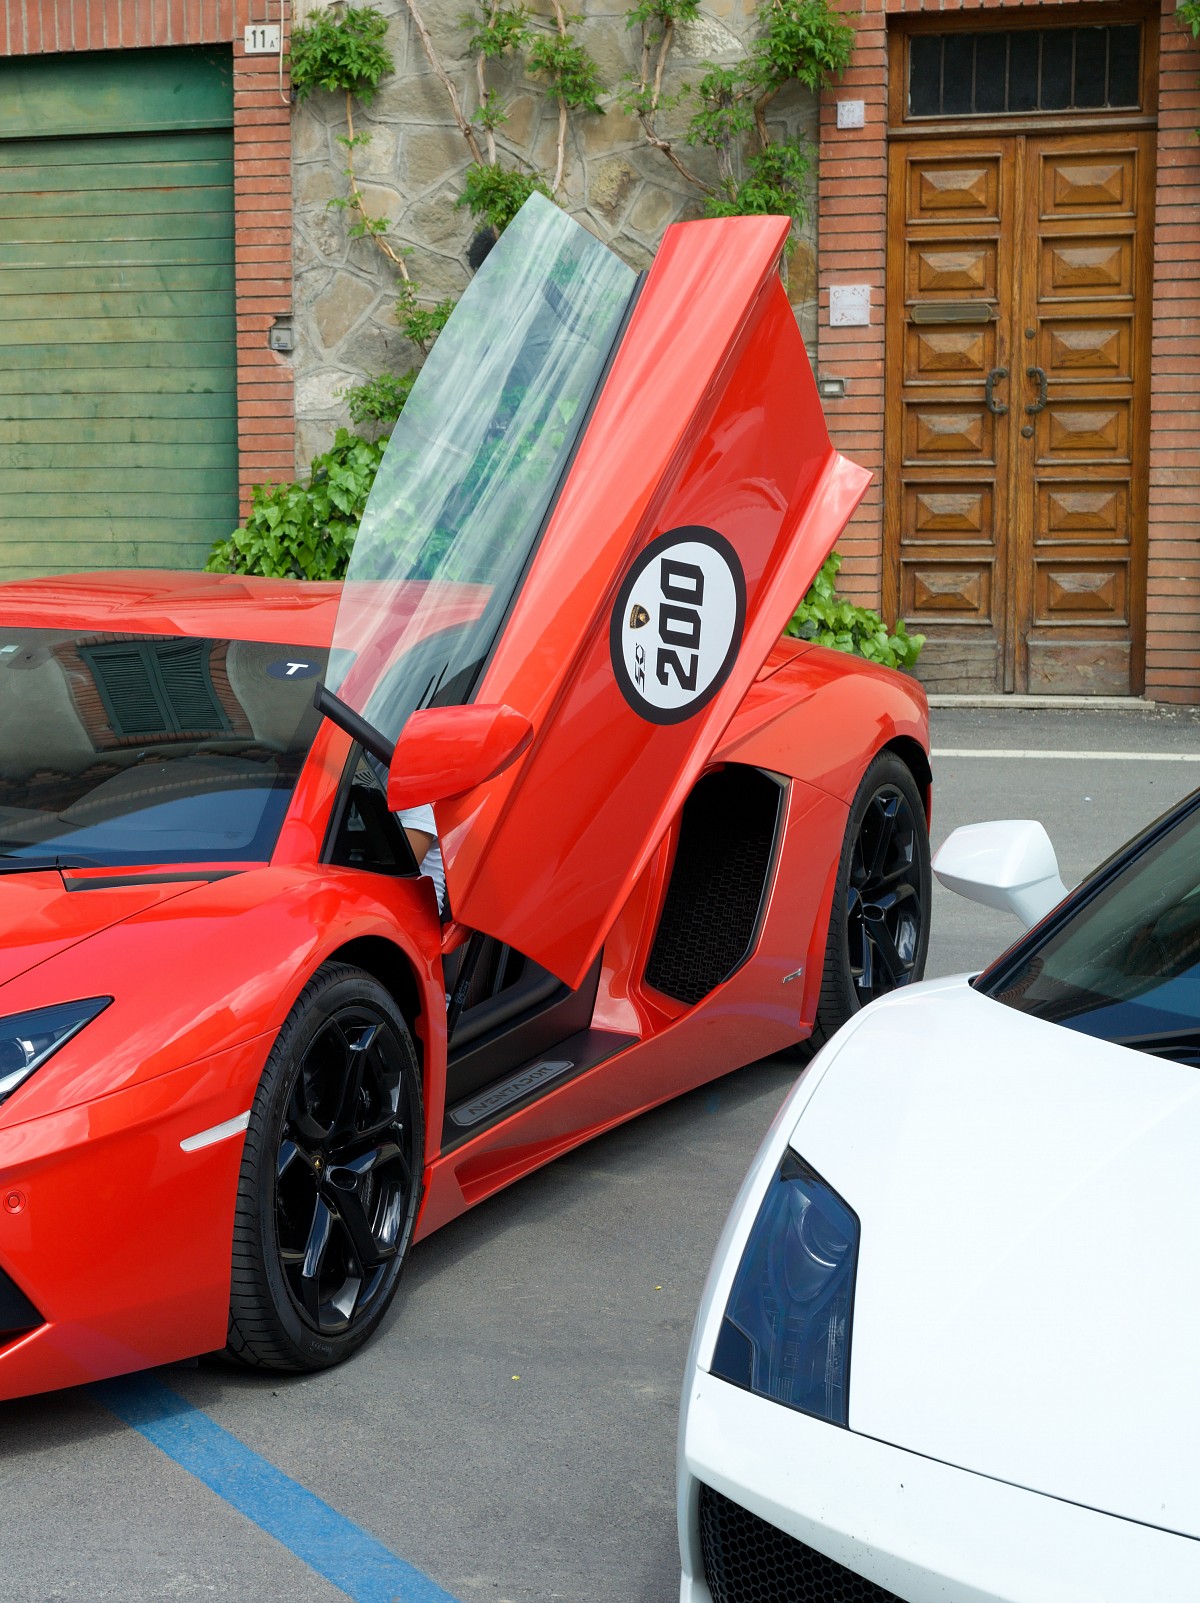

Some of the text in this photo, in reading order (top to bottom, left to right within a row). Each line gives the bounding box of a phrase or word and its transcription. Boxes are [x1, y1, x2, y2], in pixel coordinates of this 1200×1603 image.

[656, 557, 705, 692] 200
[285, 662, 309, 675] T
[468, 1066, 554, 1116] AVENTADOR
